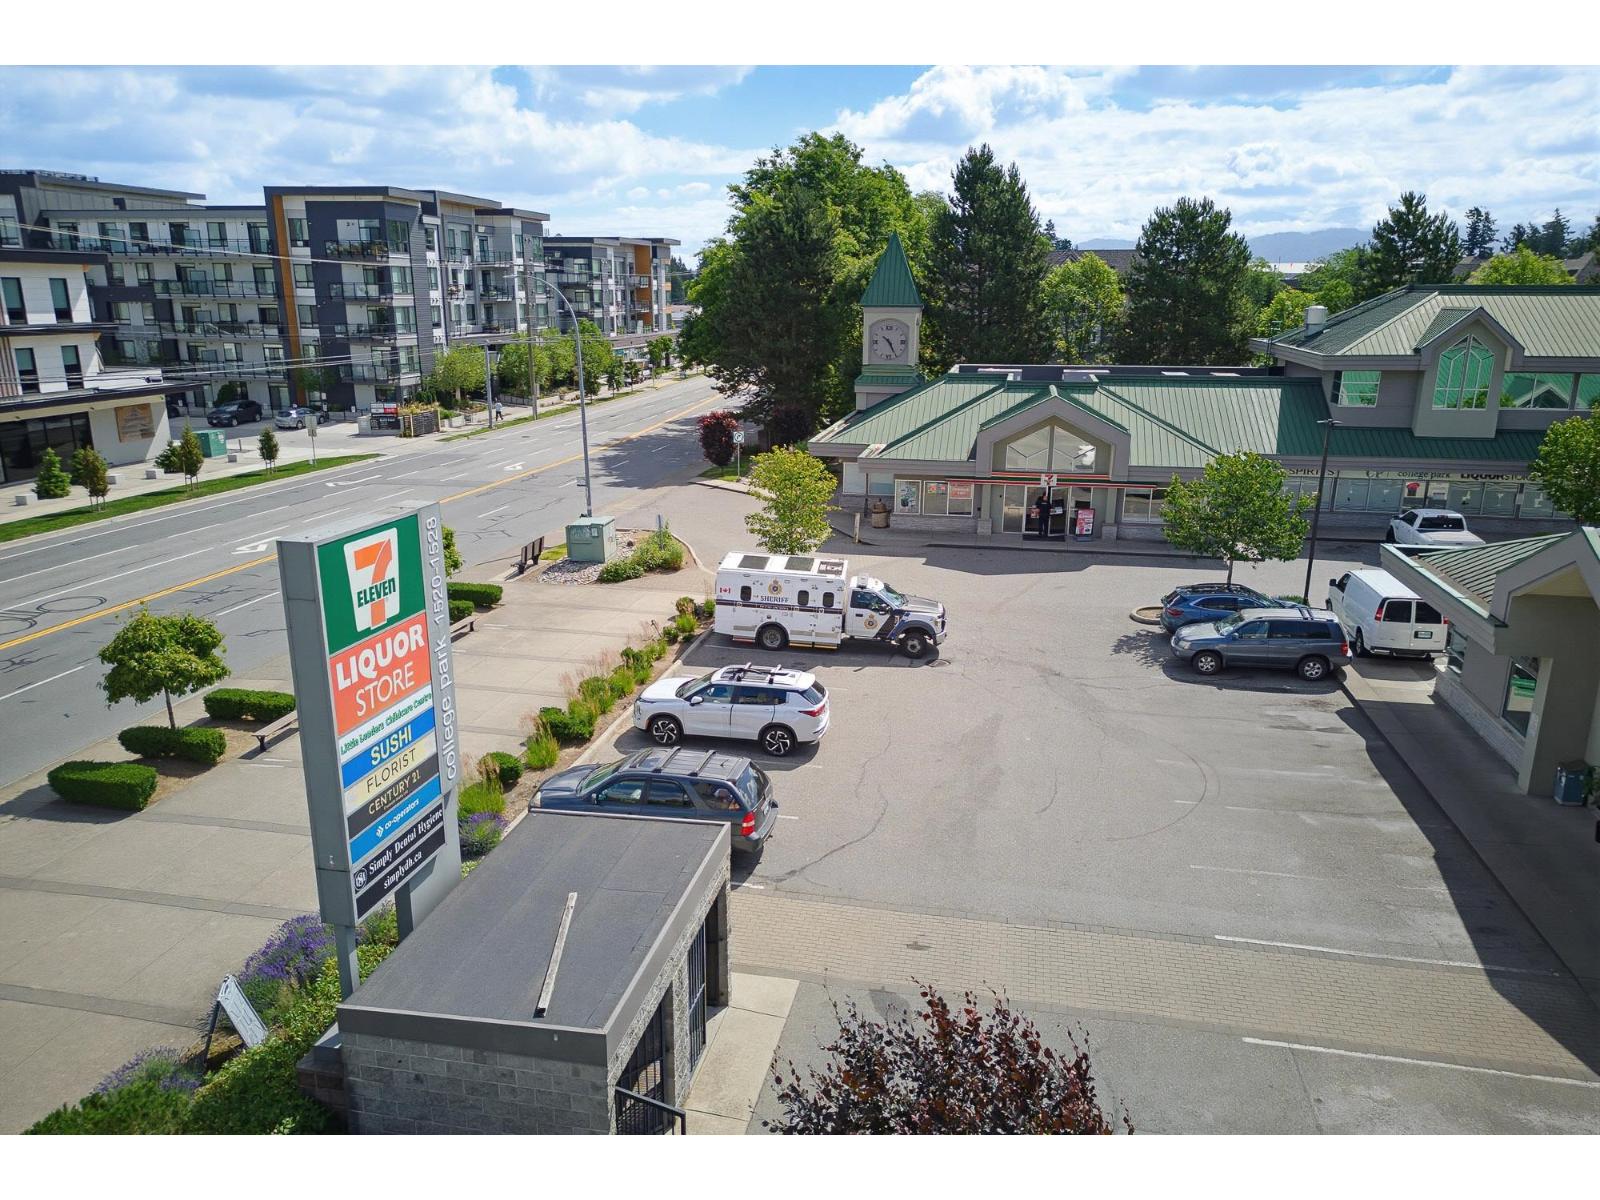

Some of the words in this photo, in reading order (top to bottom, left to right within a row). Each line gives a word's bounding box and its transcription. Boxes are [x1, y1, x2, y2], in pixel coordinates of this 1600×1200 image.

[353, 538, 393, 628] 7
[426, 516, 445, 626] 1520-1528
[760, 595, 789, 603] SHERIFF
[335, 623, 425, 691] LIQUOR
[434, 634, 452, 690] park
[355, 661, 416, 717] STORE
[370, 724, 412, 766] SUSHI
[440, 696, 457, 780] college
[366, 747, 416, 793] FLORIST
[368, 774, 410, 815] CENTURY
[411, 769, 420, 784] 21
[368, 849, 393, 875] Simply
[394, 828, 417, 854] Dental
[417, 809, 443, 835] Hygiene
[384, 798, 420, 830] co-operators
[383, 851, 422, 890] simplydh.ca
